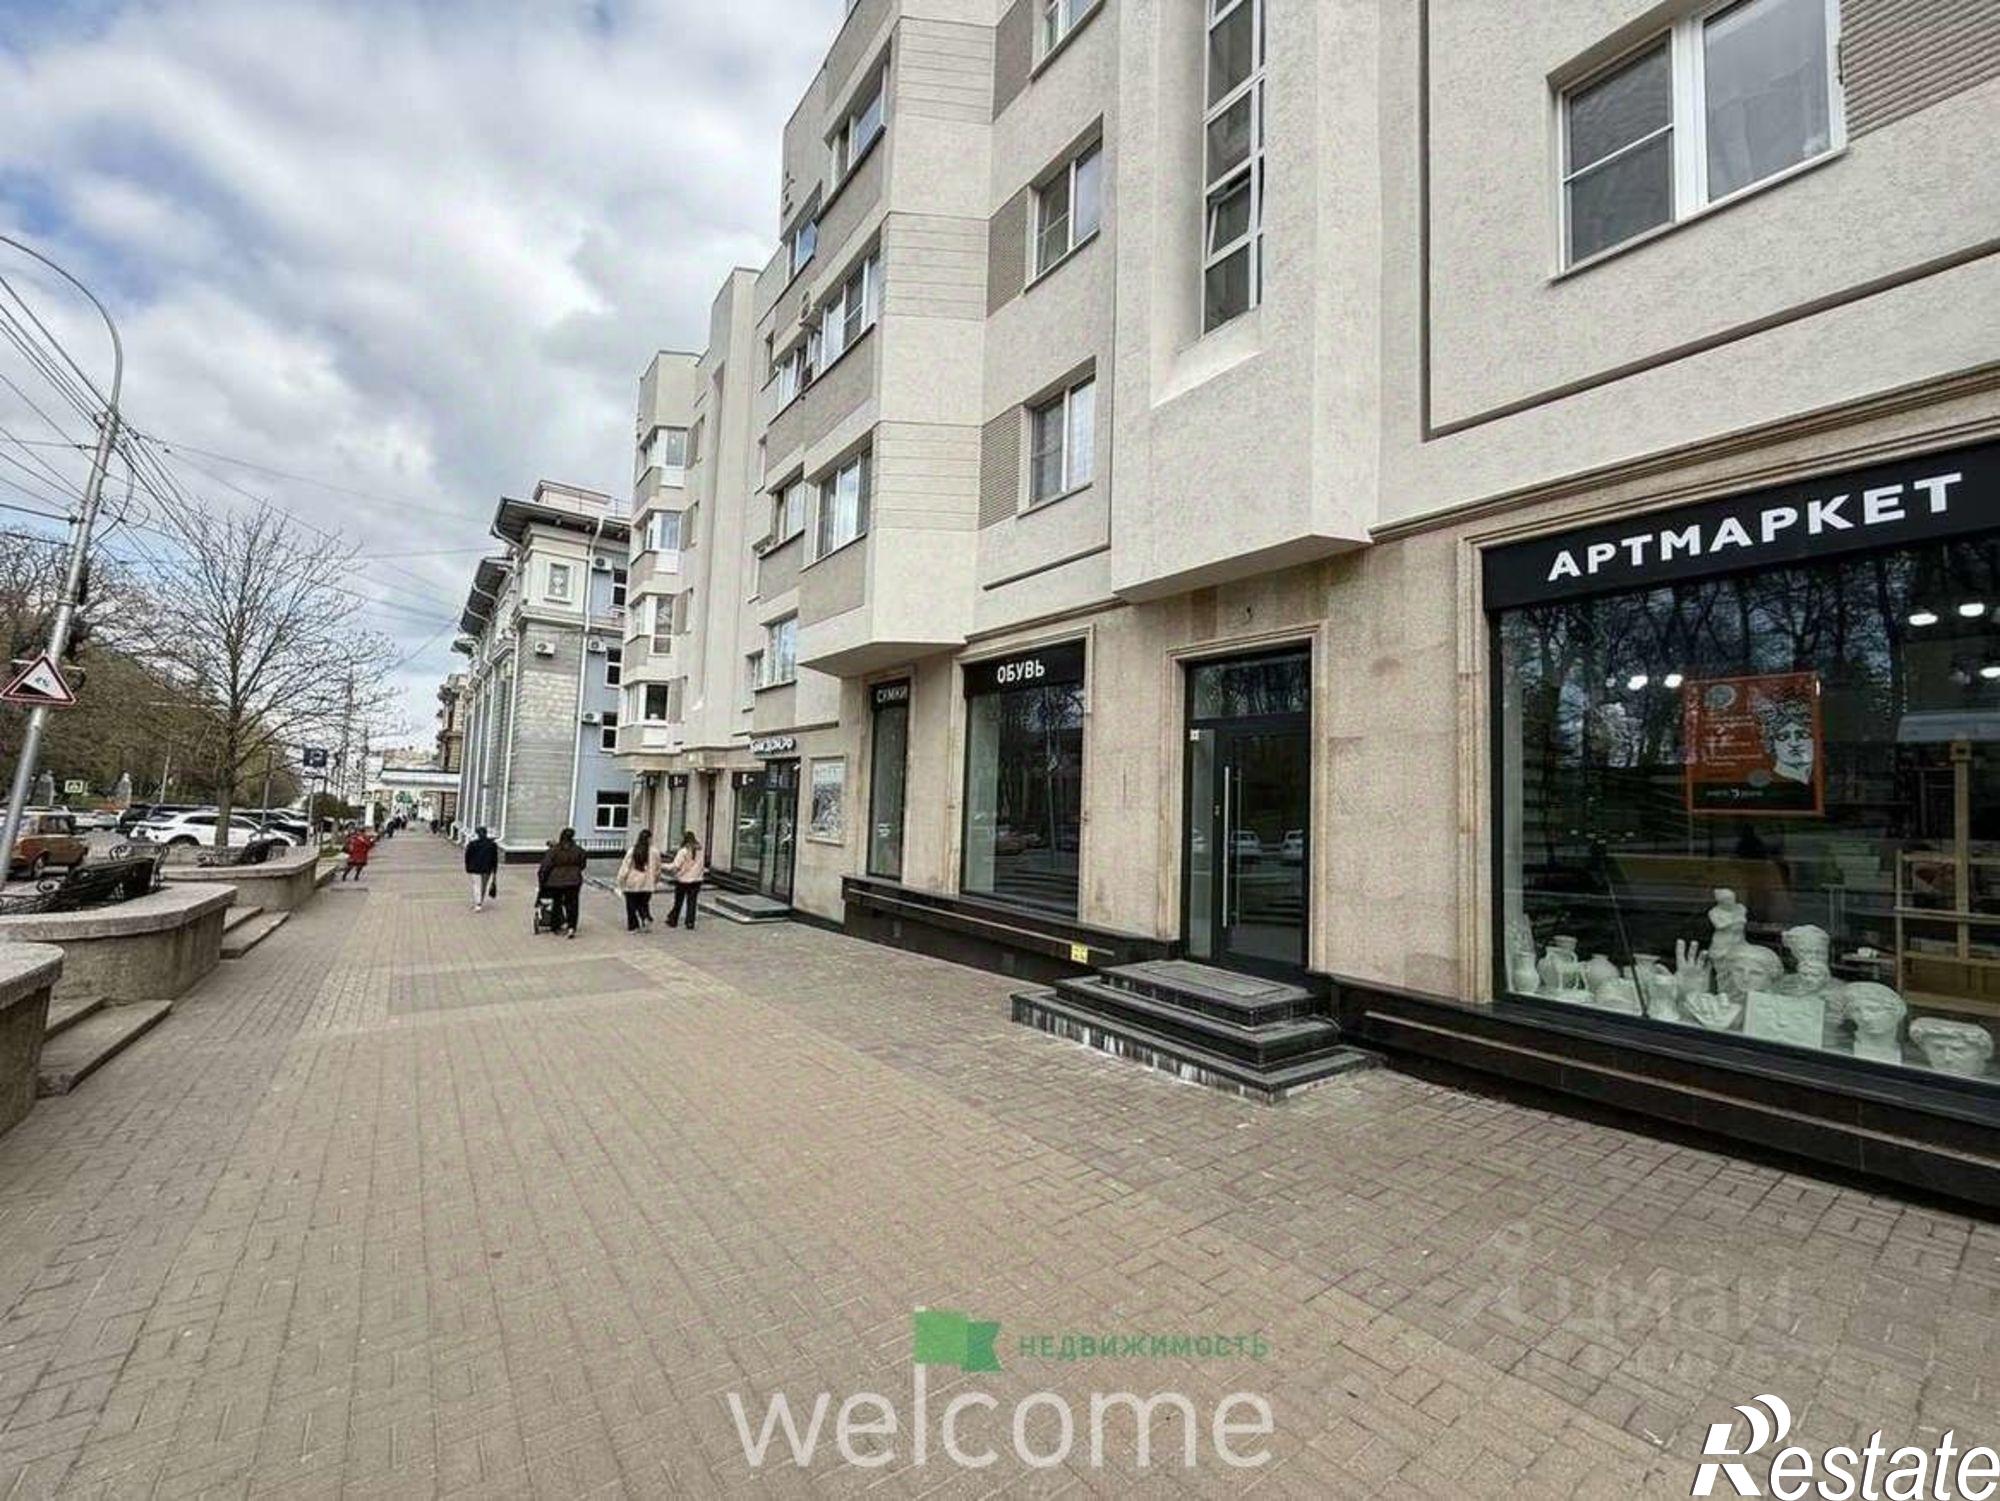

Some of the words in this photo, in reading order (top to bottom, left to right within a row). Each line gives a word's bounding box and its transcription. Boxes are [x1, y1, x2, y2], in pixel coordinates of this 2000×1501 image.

[1547, 471, 1963, 582] АРТМАРКЕТ
[996, 659, 1046, 684] ОБУВЬ
[876, 684, 909, 704] СУМКИ
